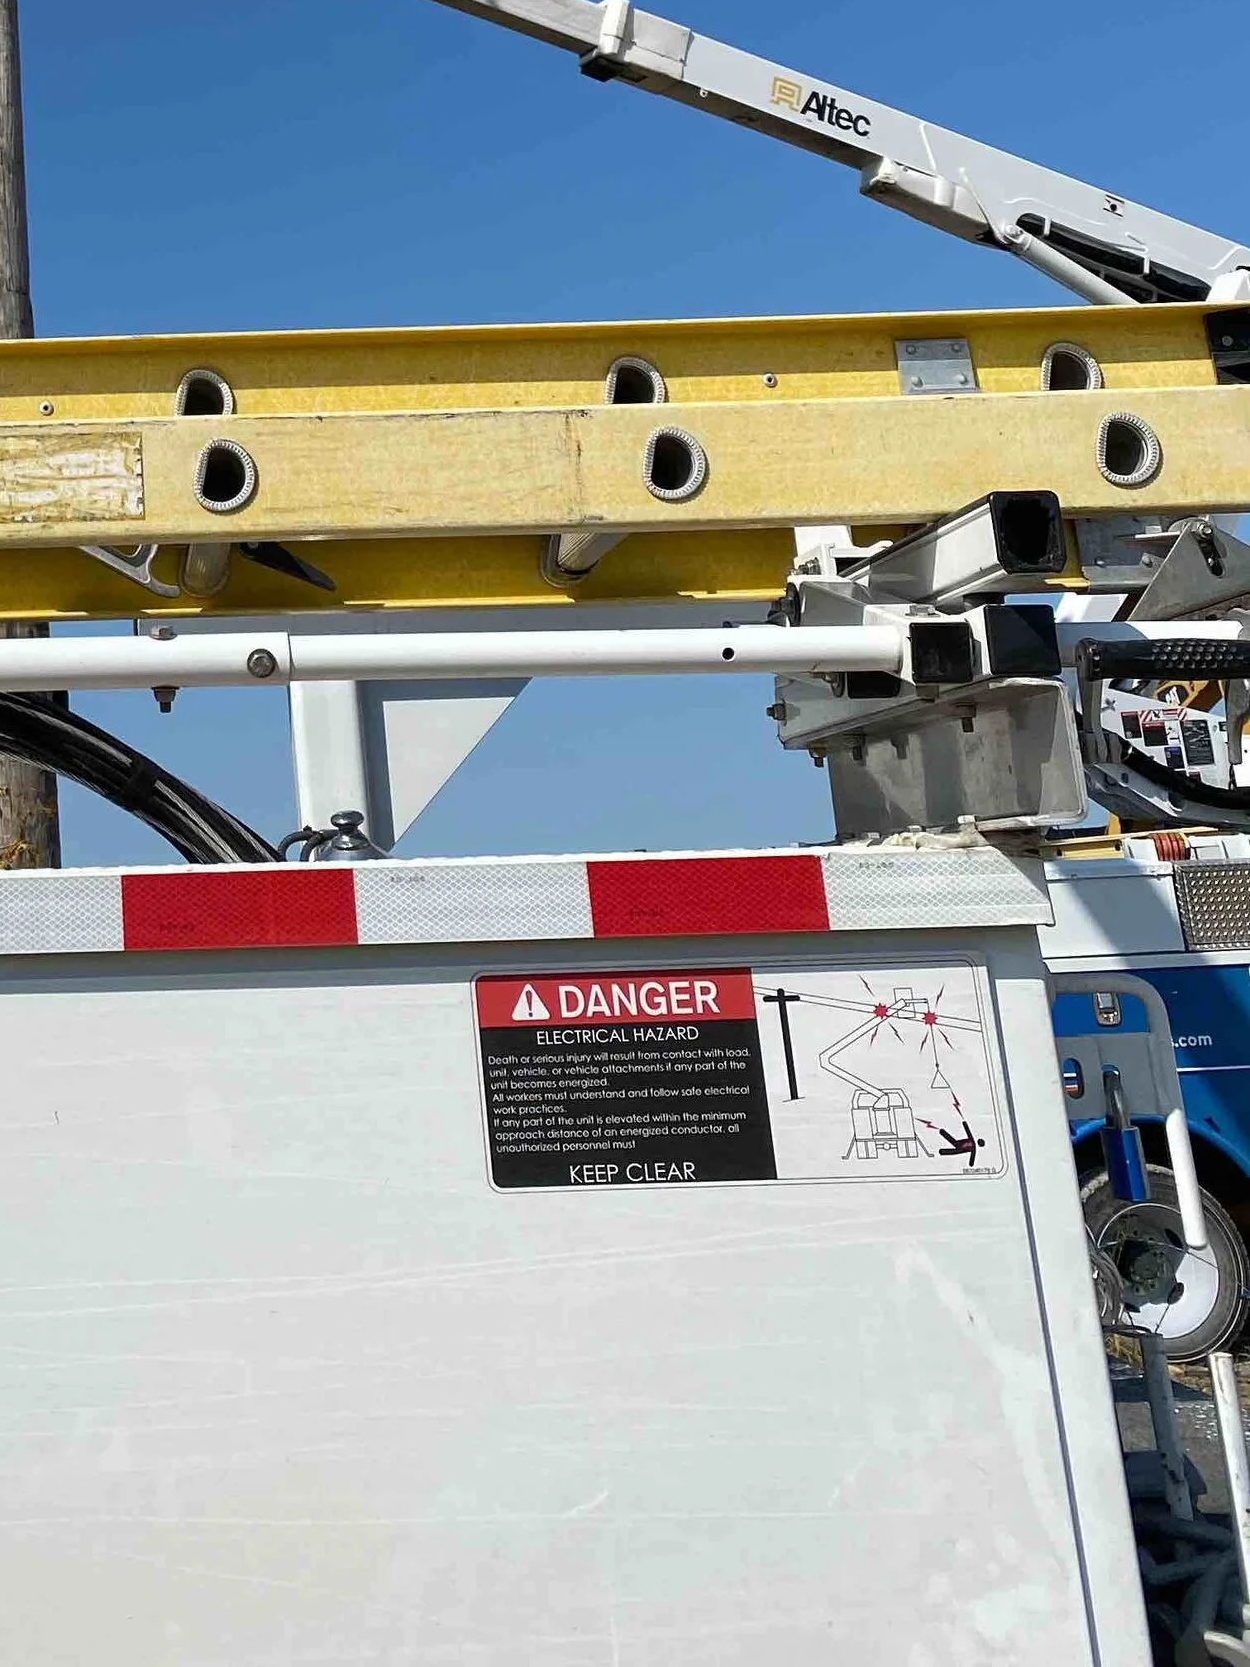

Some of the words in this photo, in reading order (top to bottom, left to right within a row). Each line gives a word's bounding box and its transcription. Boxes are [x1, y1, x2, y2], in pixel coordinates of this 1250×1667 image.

[800, 90, 871, 137] Altec
[558, 980, 721, 1019] DANGER
[536, 1028, 630, 1045] ELECTRICAL
[633, 1026, 699, 1042] HAZARD
[487, 1055, 518, 1065] Death
[520, 1056, 530, 1064] or
[532, 1053, 564, 1064] serious
[566, 1053, 591, 1064] injury
[593, 1051, 609, 1061] will
[610, 1051, 635, 1061] result
[637, 1050, 660, 1060] from
[662, 1048, 701, 1059] contact
[703, 1048, 724, 1058] with
[552, 1067, 562, 1075] or
[564, 1065, 599, 1075] vehicle
[601, 1063, 664, 1074] attachments
[666, 1063, 671, 1072] if
[674, 1064, 692, 1073] any
[695, 1061, 715, 1072] part
[717, 1060, 728, 1069] of
[730, 1060, 746, 1069] the
[490, 1080, 508, 1090] unit
[510, 1079, 557, 1090] becomes
[558, 1077, 609, 1089] energized.
[492, 1093, 504, 1102] All
[506, 1092, 543, 1102] workers
[544, 1091, 567, 1101] must
[570, 1089, 626, 1100] understand
[628, 1088, 648, 1098] and
[650, 1087, 679, 1097] follow
[681, 1086, 702, 1096] safe
[704, 1085, 750, 1096] electrical
[493, 1105, 517, 1115] work
[519, 1104, 567, 1116] practices.
[493, 1117, 500, 1127] If
[502, 1118, 521, 1128] any
[523, 1117, 543, 1129] part
[545, 1117, 556, 1126] of
[558, 1116, 574, 1125] the
[576, 1115, 594, 1125] unit
[596, 1115, 604, 1125] is
[605, 1113, 650, 1124] elevated
[652, 1112, 681, 1123] within
[683, 1112, 699, 1122] the
[701, 1111, 747, 1121] minimum
[495, 1129, 545, 1141] approach
[547, 1127, 589, 1139] distance
[591, 1127, 602, 1137] of
[604, 1128, 618, 1137] an
[619, 1125, 669, 1138] energized
[728, 1123, 740, 1133] all
[496, 1141, 560, 1153] unauthorized
[562, 1140, 611, 1152] personnel
[612, 1139, 636, 1149] must
[569, 1163, 619, 1184] KEEP
[626, 1161, 696, 1182] CLEAR
